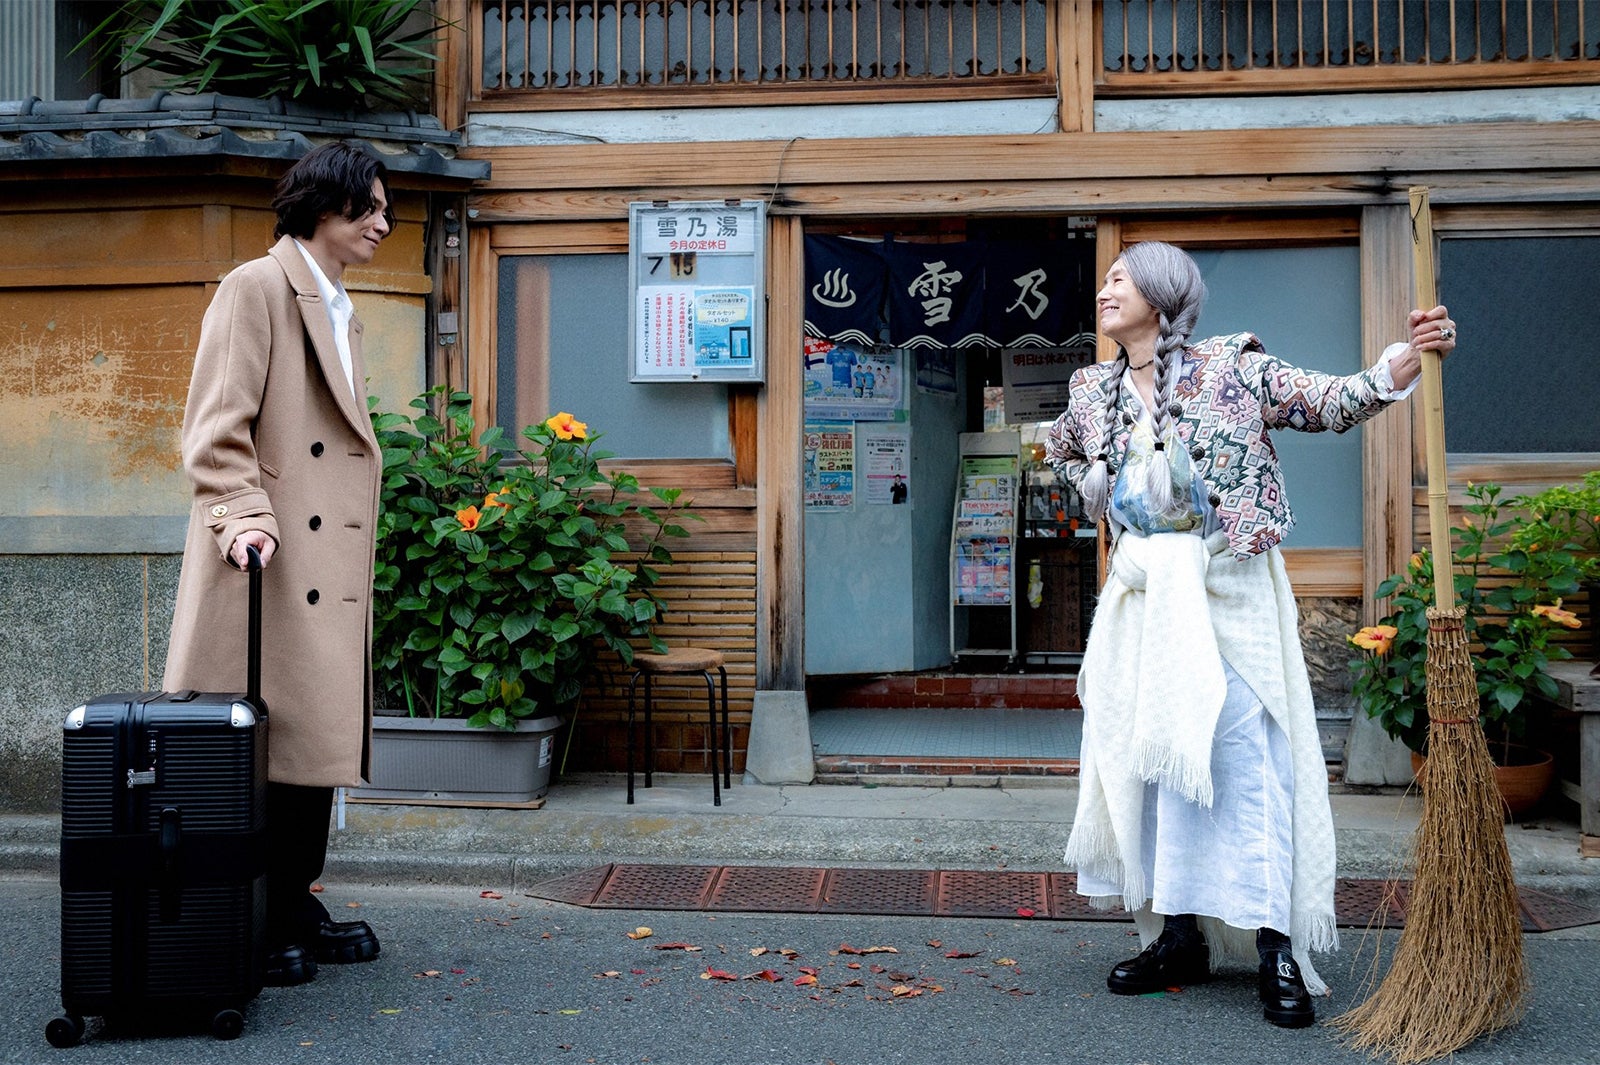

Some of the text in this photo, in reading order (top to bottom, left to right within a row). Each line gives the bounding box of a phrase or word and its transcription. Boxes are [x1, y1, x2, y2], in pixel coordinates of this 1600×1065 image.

[657, 216, 738, 238] 雪乃湯
[669, 240, 727, 250] 今月の定休日
[647, 256, 664, 275] 7
